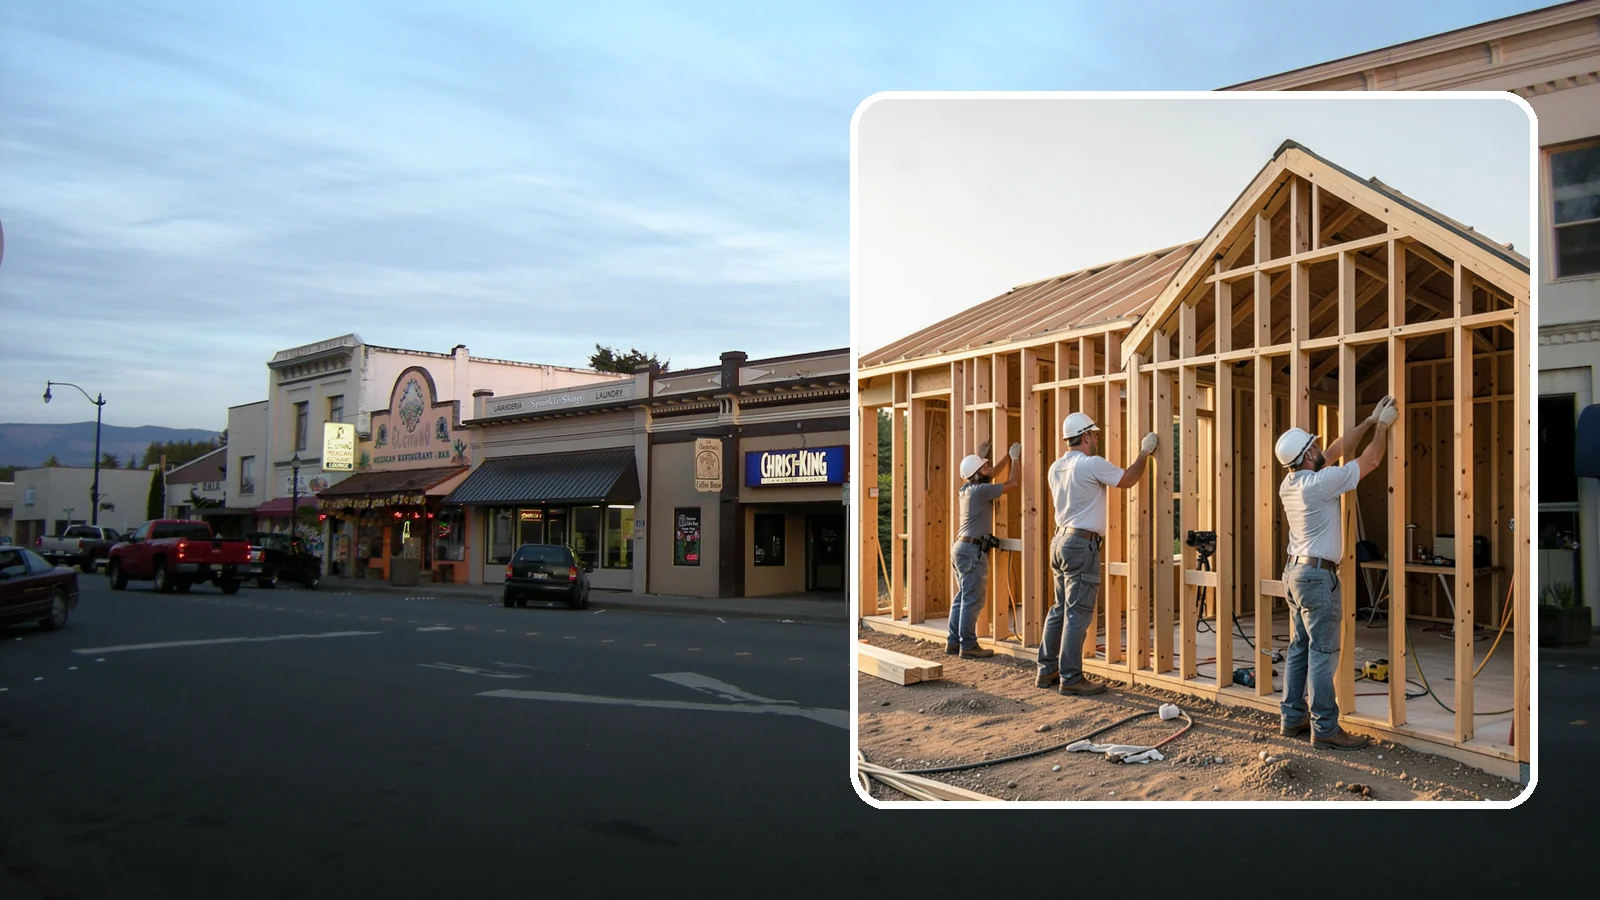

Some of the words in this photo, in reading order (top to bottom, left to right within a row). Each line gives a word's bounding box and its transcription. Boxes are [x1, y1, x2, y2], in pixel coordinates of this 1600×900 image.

[562, 394, 583, 405] Shop
[595, 389, 623, 399] LAUNDRY
[493, 402, 522, 412] LAVANDERIA
[374, 455, 396, 463] MEXICAN
[397, 451, 433, 462] RESTAURANT
[438, 451, 449, 459] BAR
[761, 452, 797, 478] CHRIST
[799, 450, 827, 476] KING
